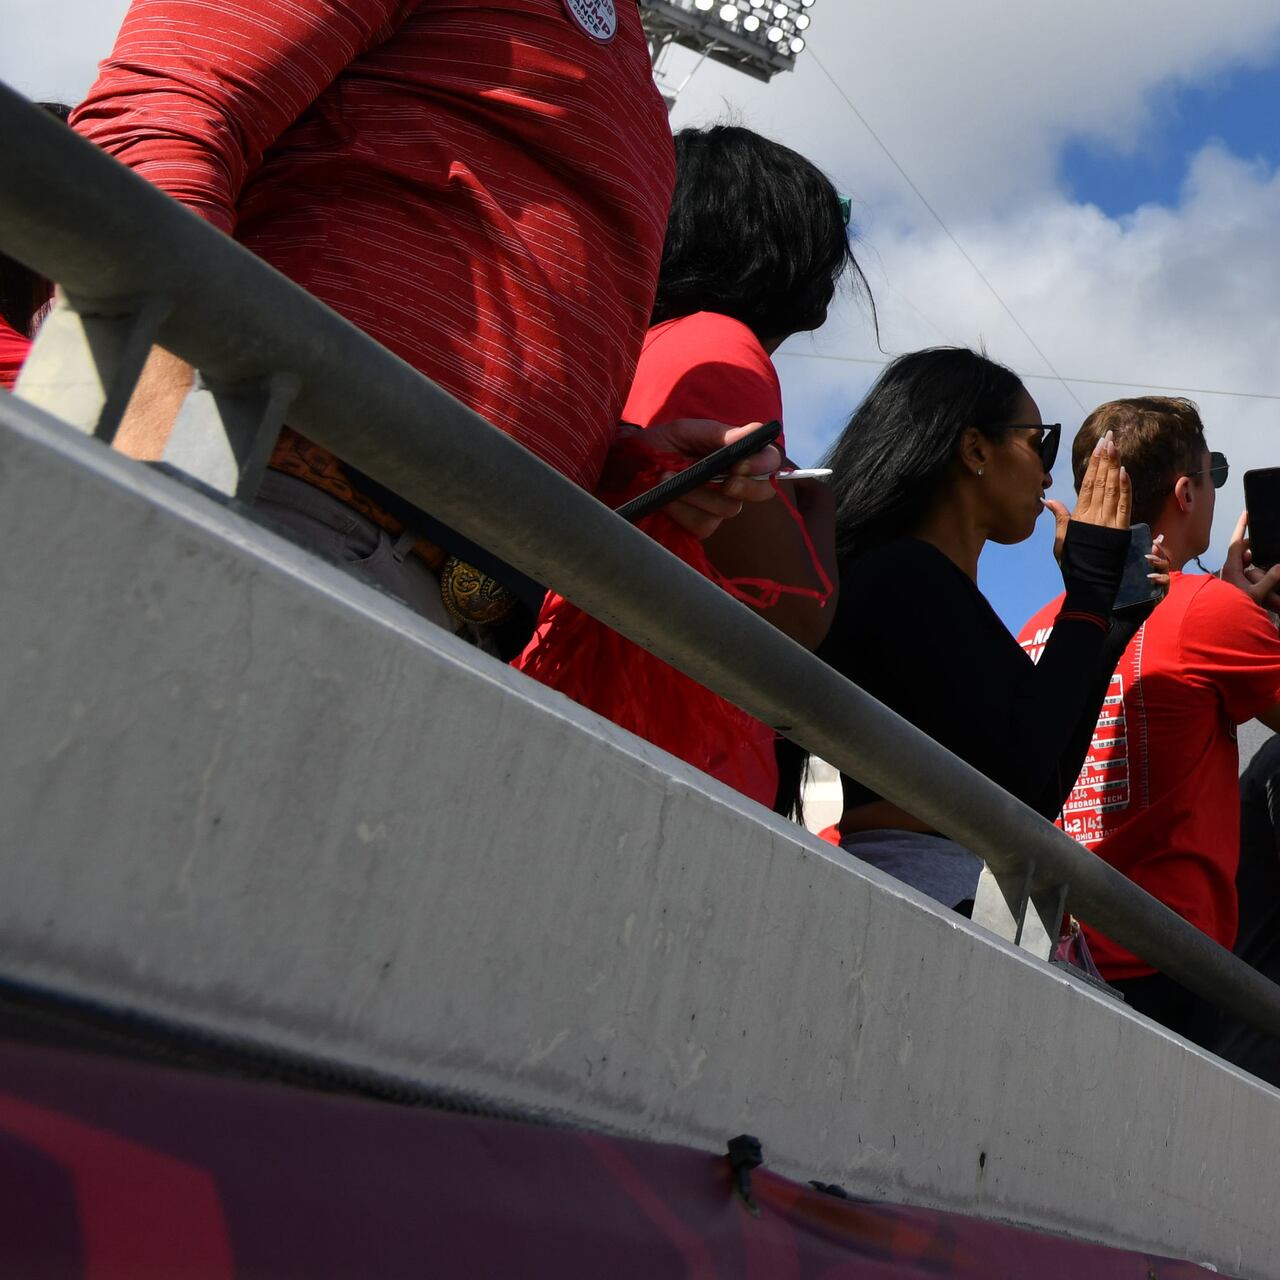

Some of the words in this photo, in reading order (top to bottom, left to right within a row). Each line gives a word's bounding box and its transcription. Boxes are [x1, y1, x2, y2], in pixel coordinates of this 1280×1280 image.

[1081, 775, 1104, 785] STATE
[1068, 798, 1101, 809] GEORGIA
[1103, 794, 1123, 803] TECH
[1075, 831, 1093, 841] OHIO
